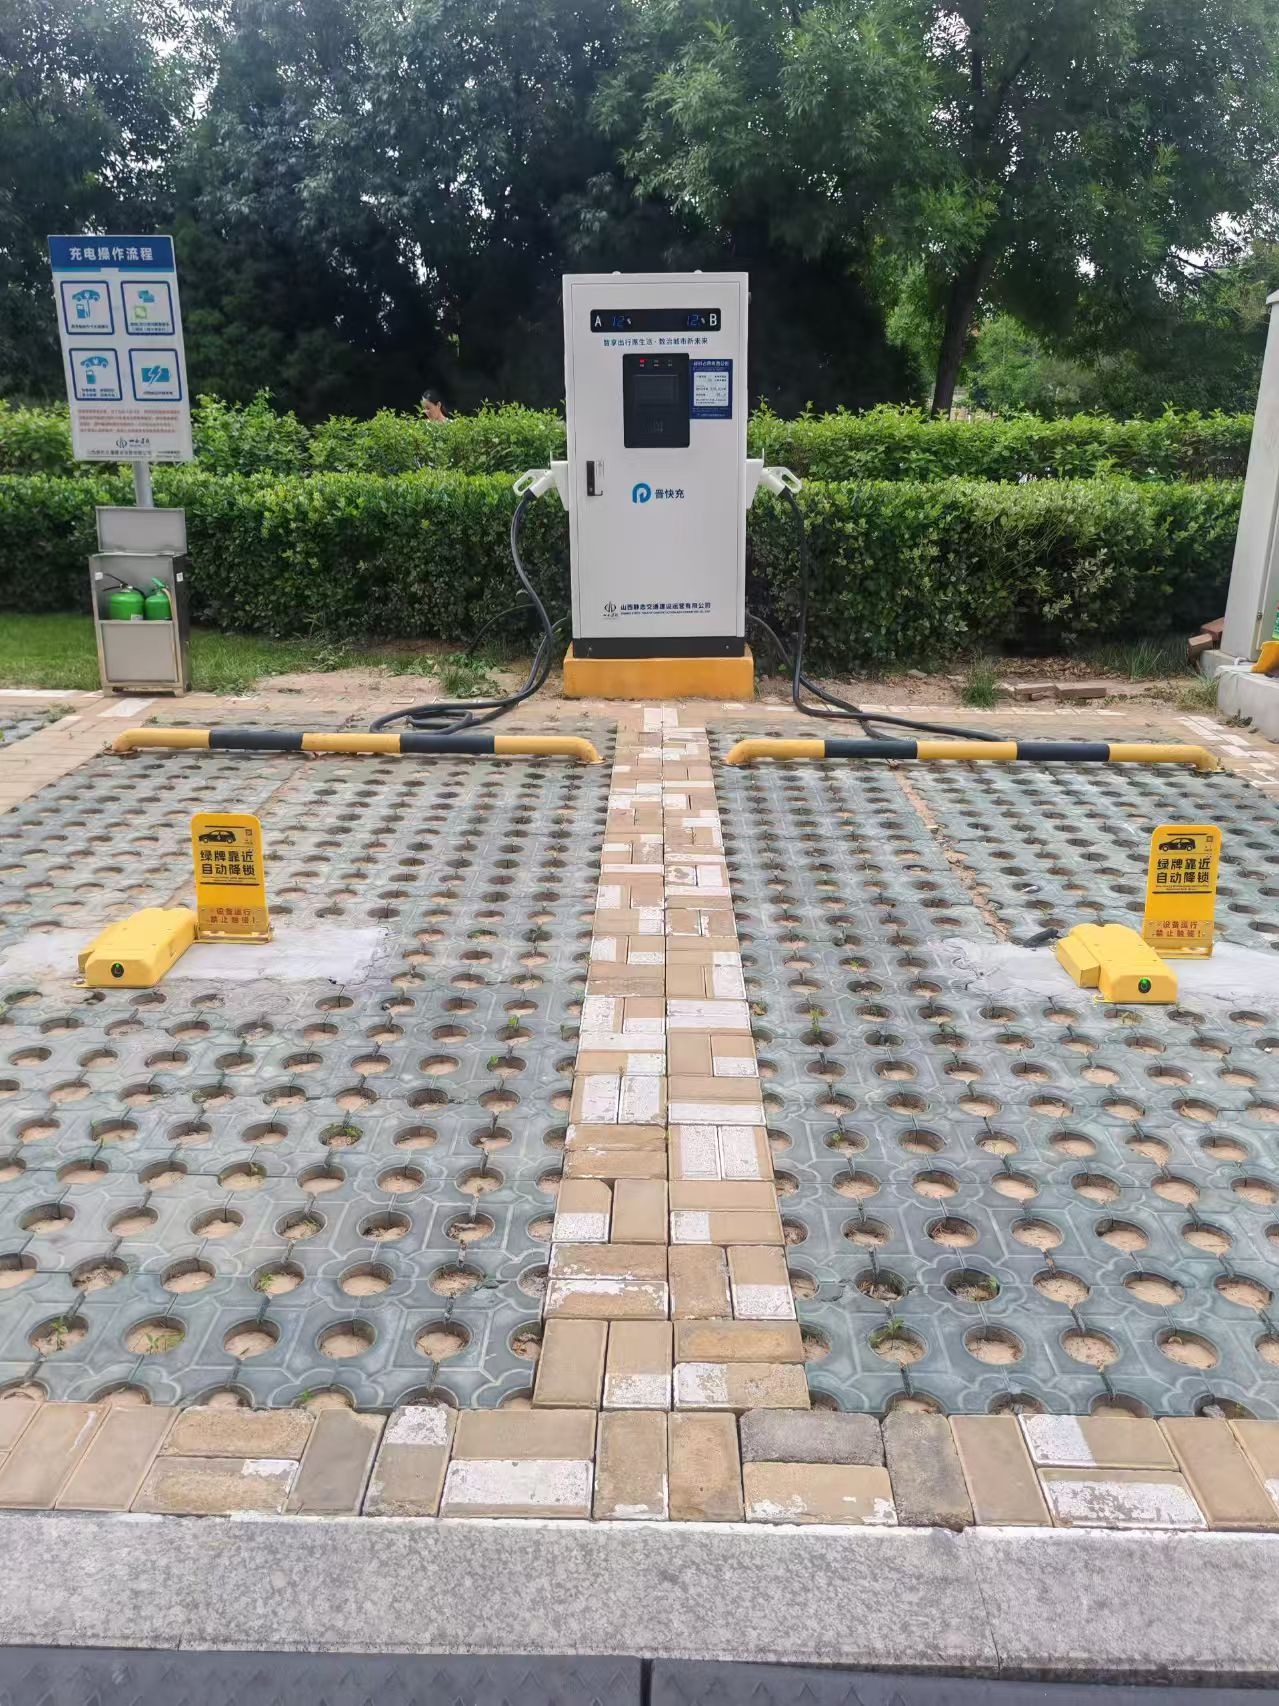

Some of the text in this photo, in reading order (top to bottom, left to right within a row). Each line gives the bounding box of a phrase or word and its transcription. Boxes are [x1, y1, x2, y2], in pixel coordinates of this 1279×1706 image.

[69, 247, 153, 261] 充电操作流程
[594, 316, 602, 327] A
[710, 314, 717, 326] B
[655, 489, 684, 499] 晋快充
[200, 850, 254, 862] 绿牌靠近
[203, 864, 255, 876] 自动降锁
[1157, 858, 1211, 870] 绿牌靠近
[1156, 872, 1209, 883] 自动降锁
[1163, 921, 1198, 929] 设备运行
